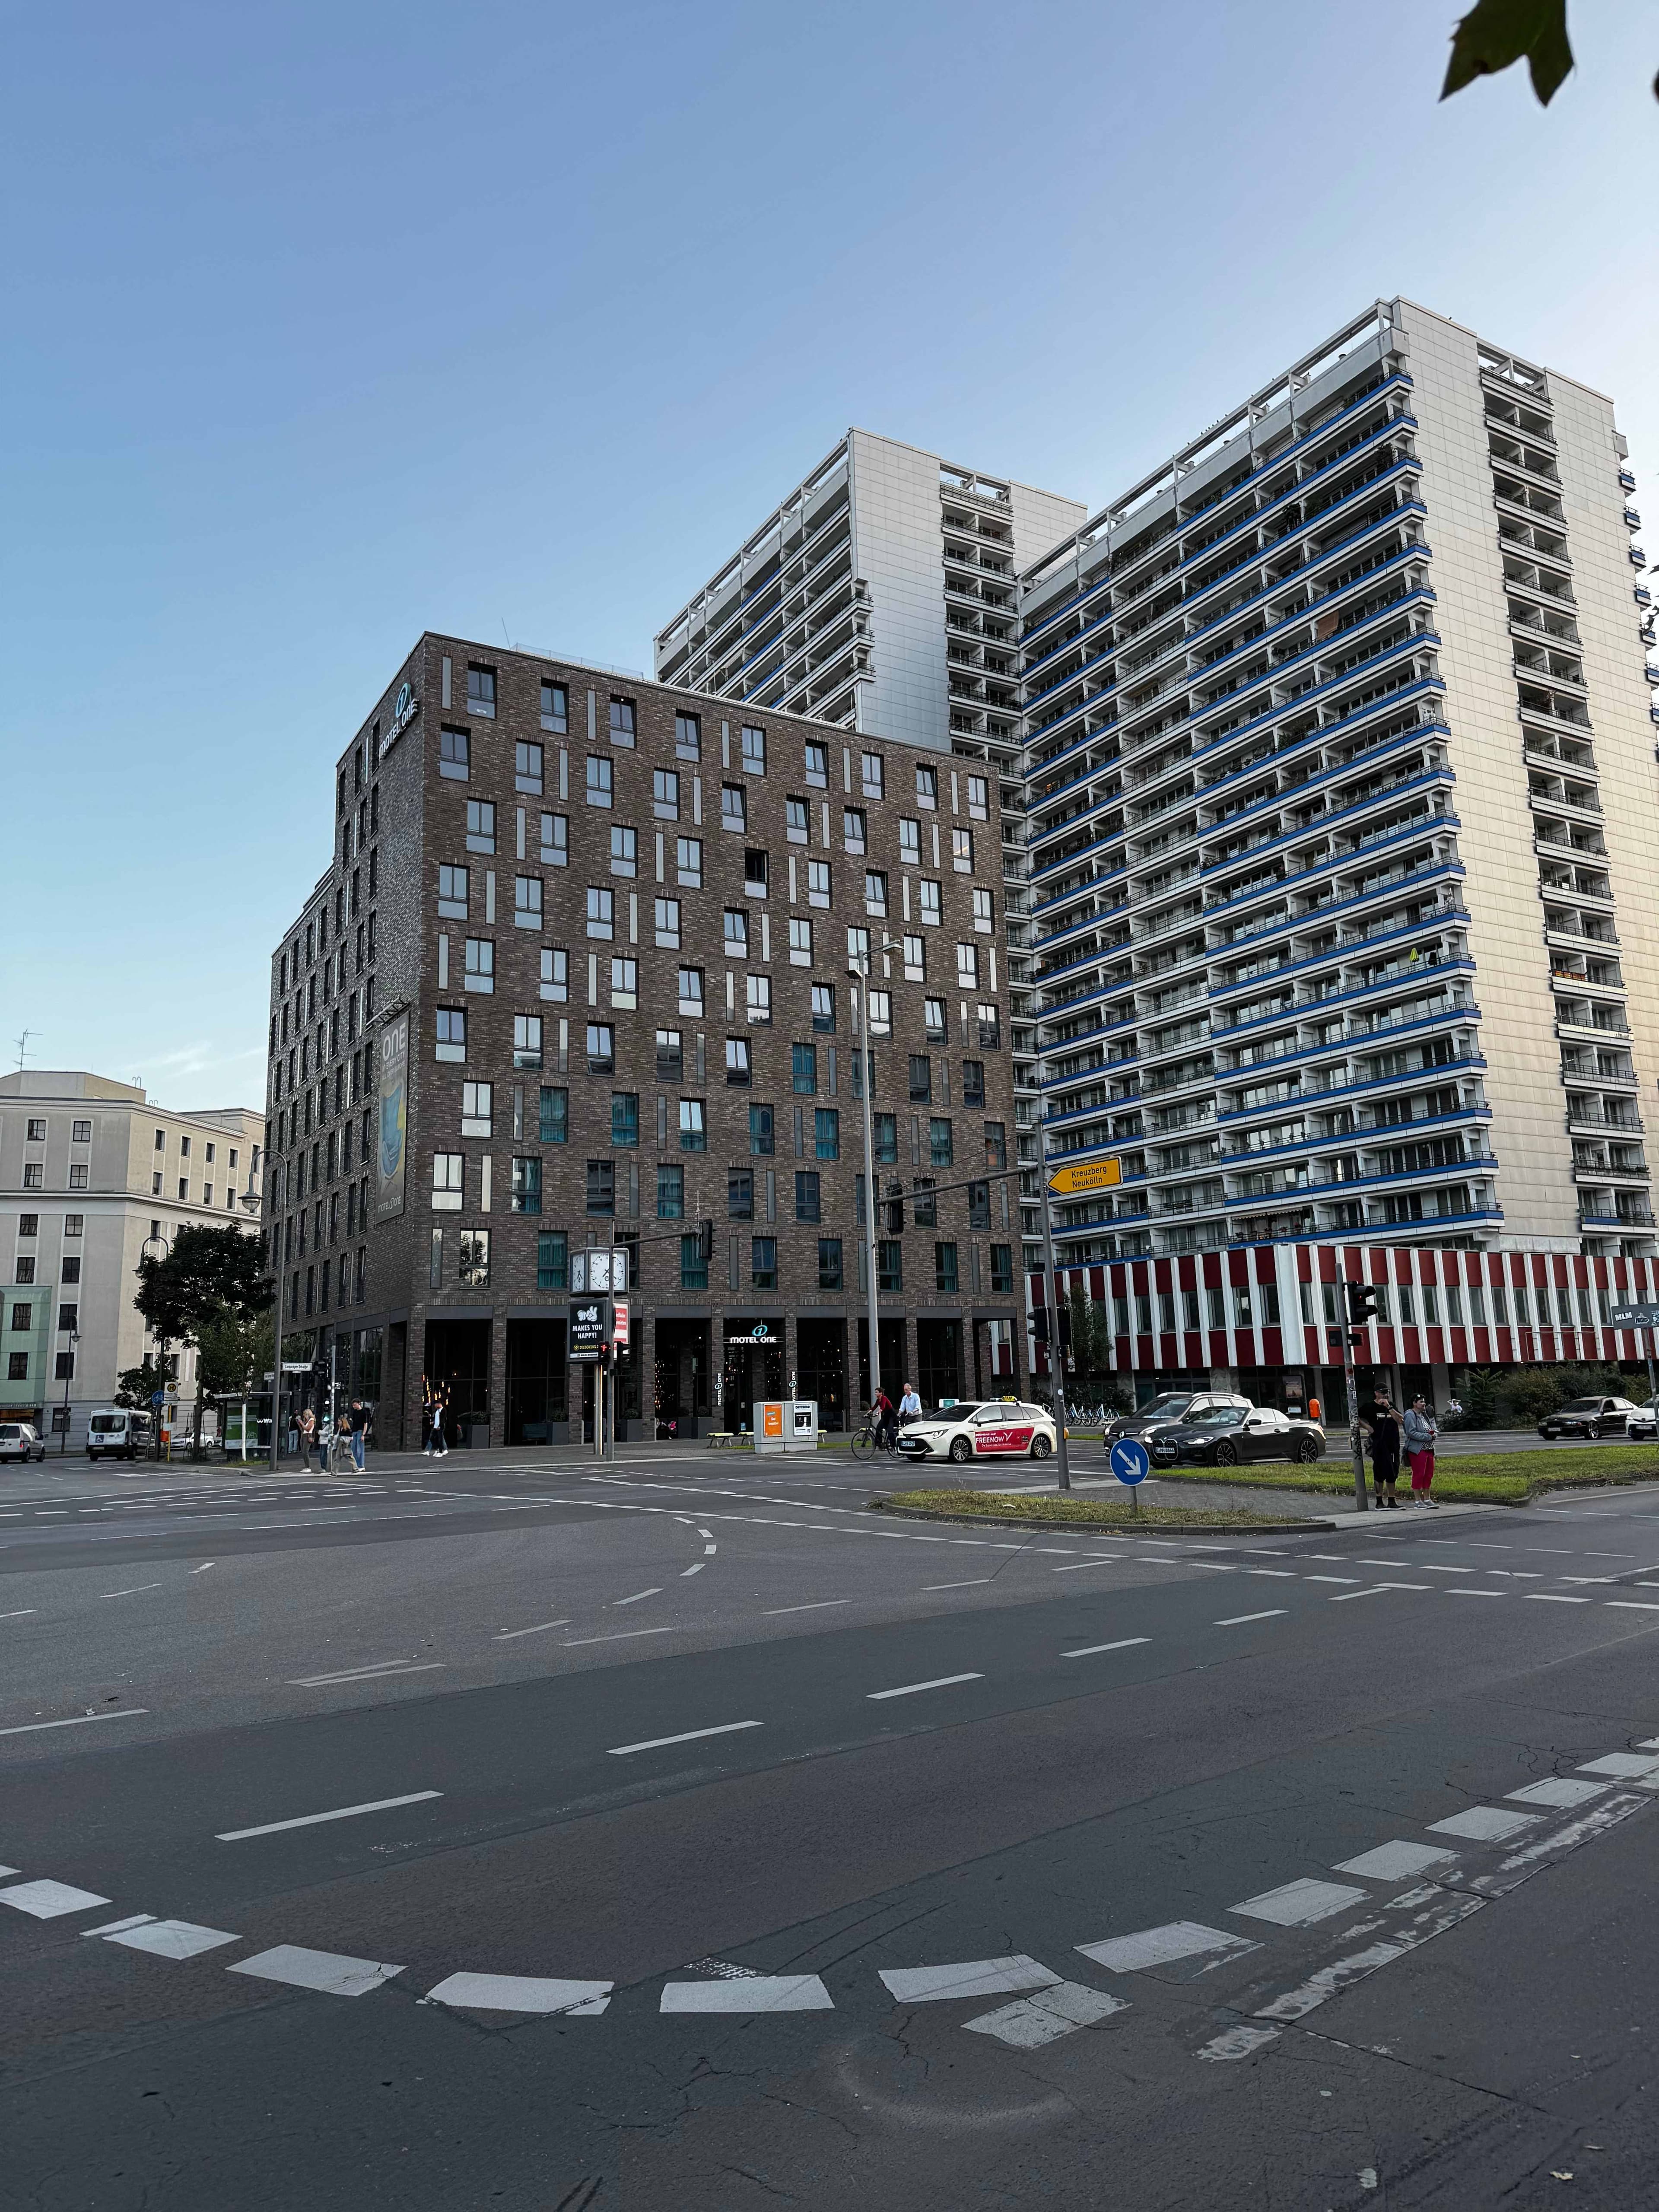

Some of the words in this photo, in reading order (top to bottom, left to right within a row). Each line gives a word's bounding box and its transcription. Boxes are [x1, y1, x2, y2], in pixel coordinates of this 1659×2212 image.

[379, 721, 400, 759] MOTEL
[401, 698, 420, 727] ONE
[383, 1023, 406, 1061] ONE
[1071, 1166, 1106, 1178] Kreuzberg
[1072, 1176, 1103, 1188] Neukölln
[378, 1201, 389, 1213] MOTEL
[1615, 1312, 1632, 1321] MLM
